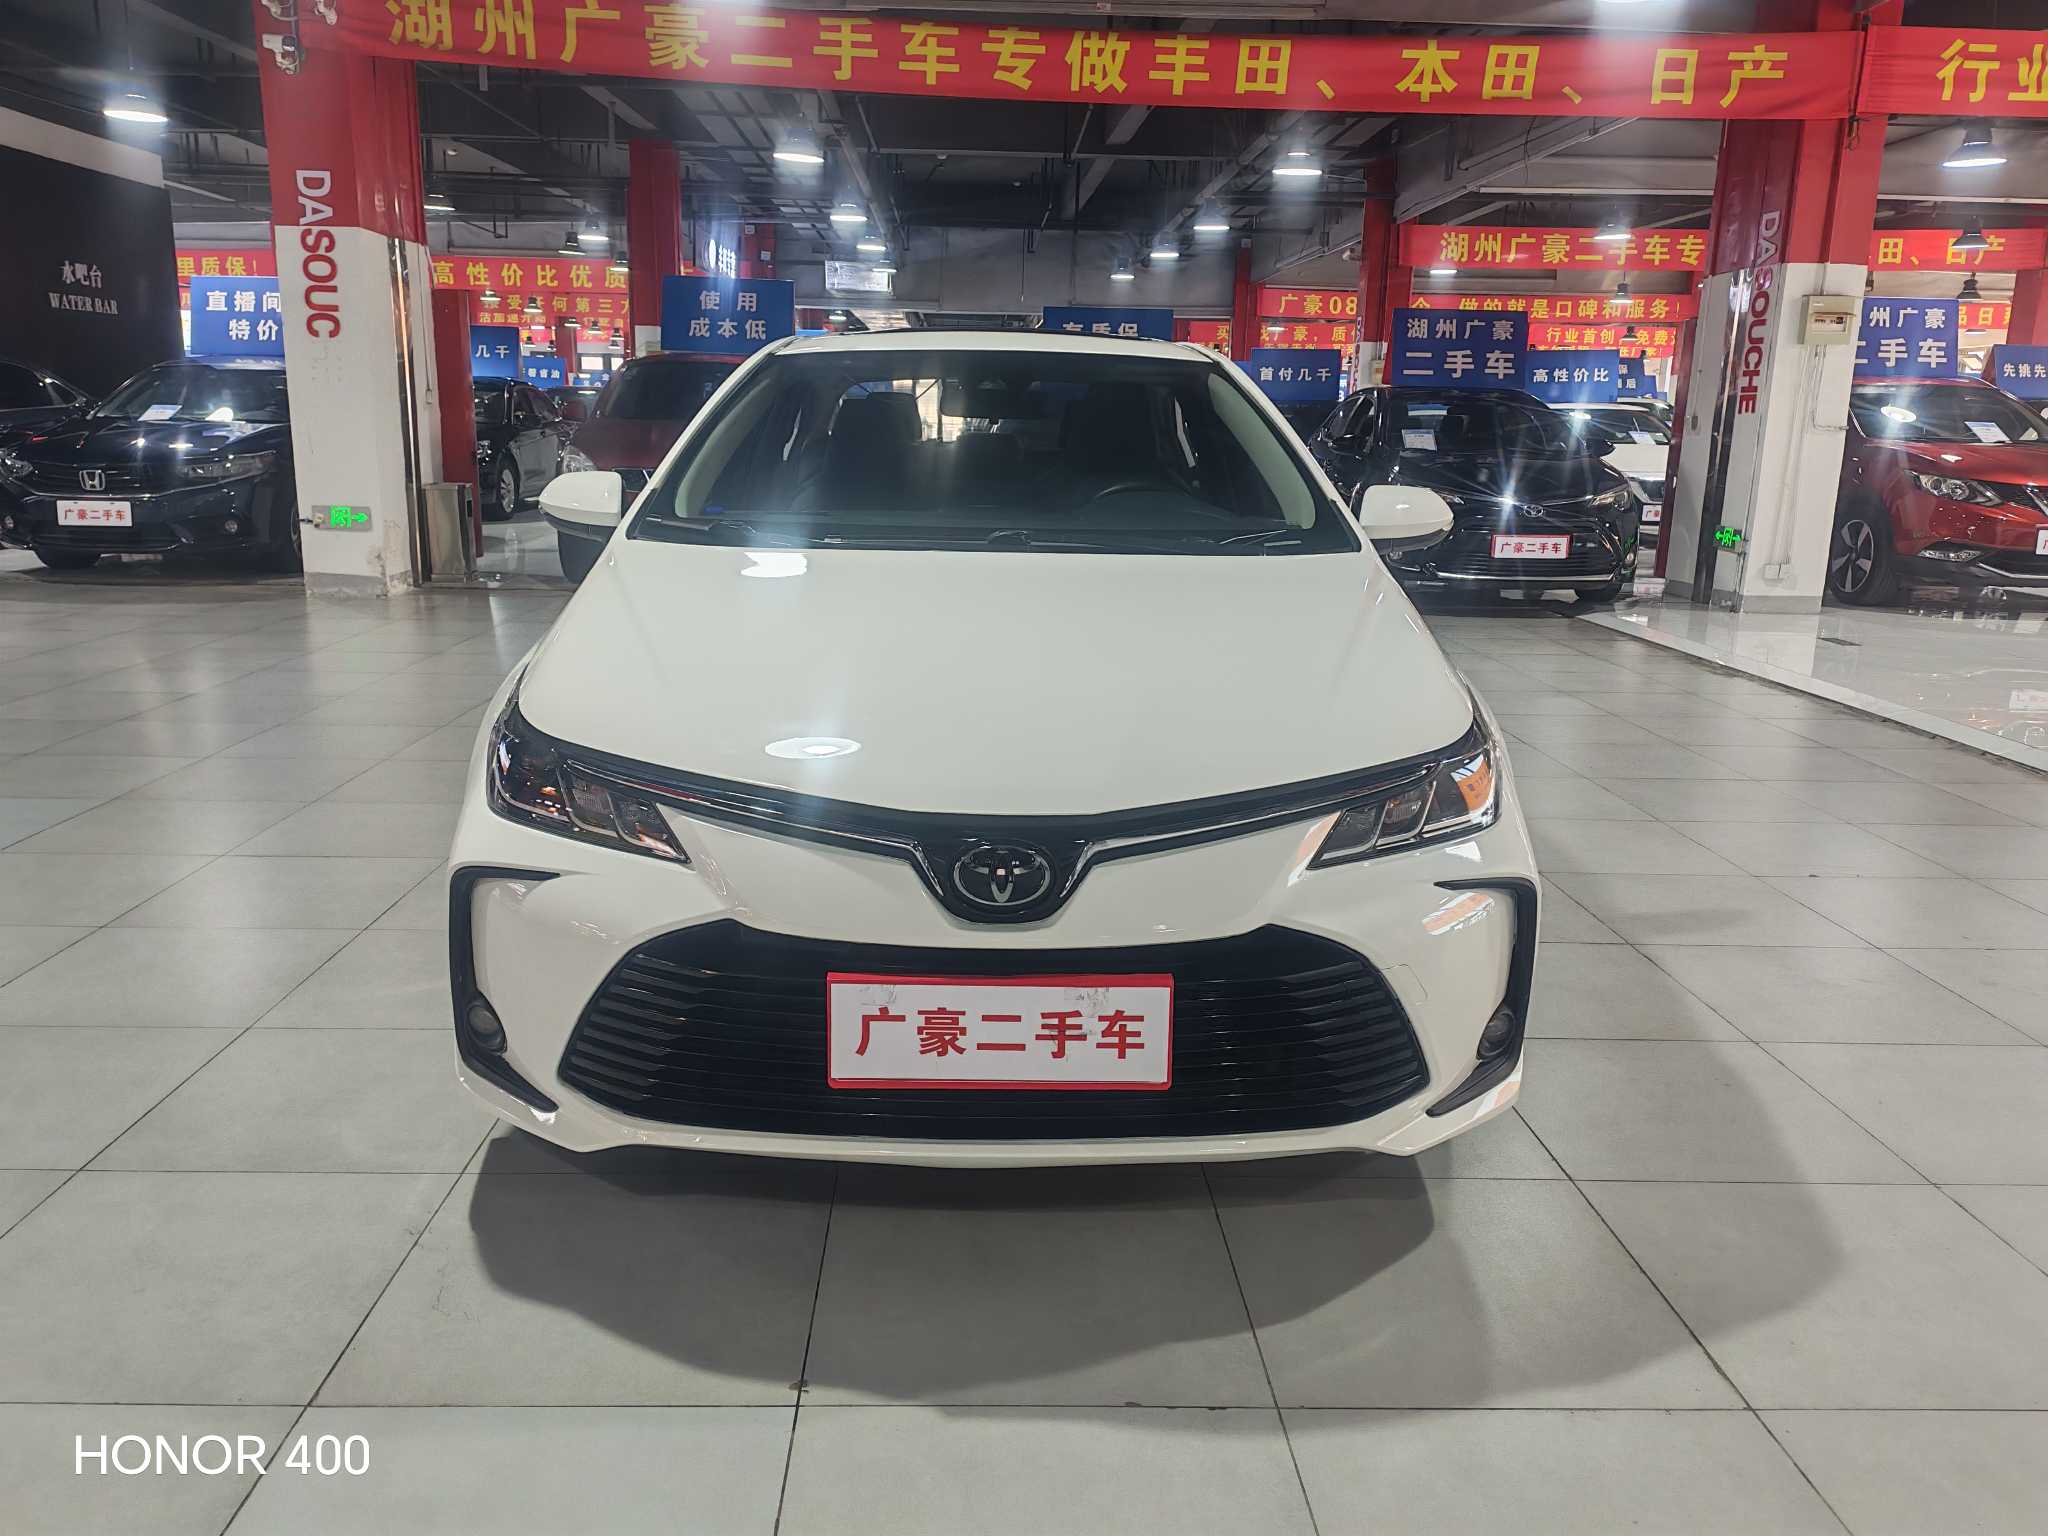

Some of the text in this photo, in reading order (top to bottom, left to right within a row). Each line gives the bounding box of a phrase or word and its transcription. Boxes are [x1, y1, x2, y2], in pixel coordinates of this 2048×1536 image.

[296, 169, 341, 338] DASOUC
[1439, 231, 1706, 266] 湖州广豪二手车专
[61, 260, 102, 289] 水吧台
[48, 292, 118, 315] WATER BAR
[700, 291, 757, 312] 使用
[1279, 294, 1357, 315] 广豪08
[1738, 211, 1781, 415] DASOUCHE
[1859, 306, 1946, 329] 州广豪
[228, 319, 278, 341] 特价
[689, 318, 766, 339] 成本低
[1407, 318, 1515, 340] 湖州广豪
[1259, 366, 1332, 383] 首付几千
[1402, 349, 1515, 380] 二手车
[1532, 367, 1610, 383] 高性价比
[64, 508, 126, 521] 广豪二手车
[1501, 542, 1562, 554] 广豪二手车
[855, 1007, 1145, 1060] 广豪二手车
